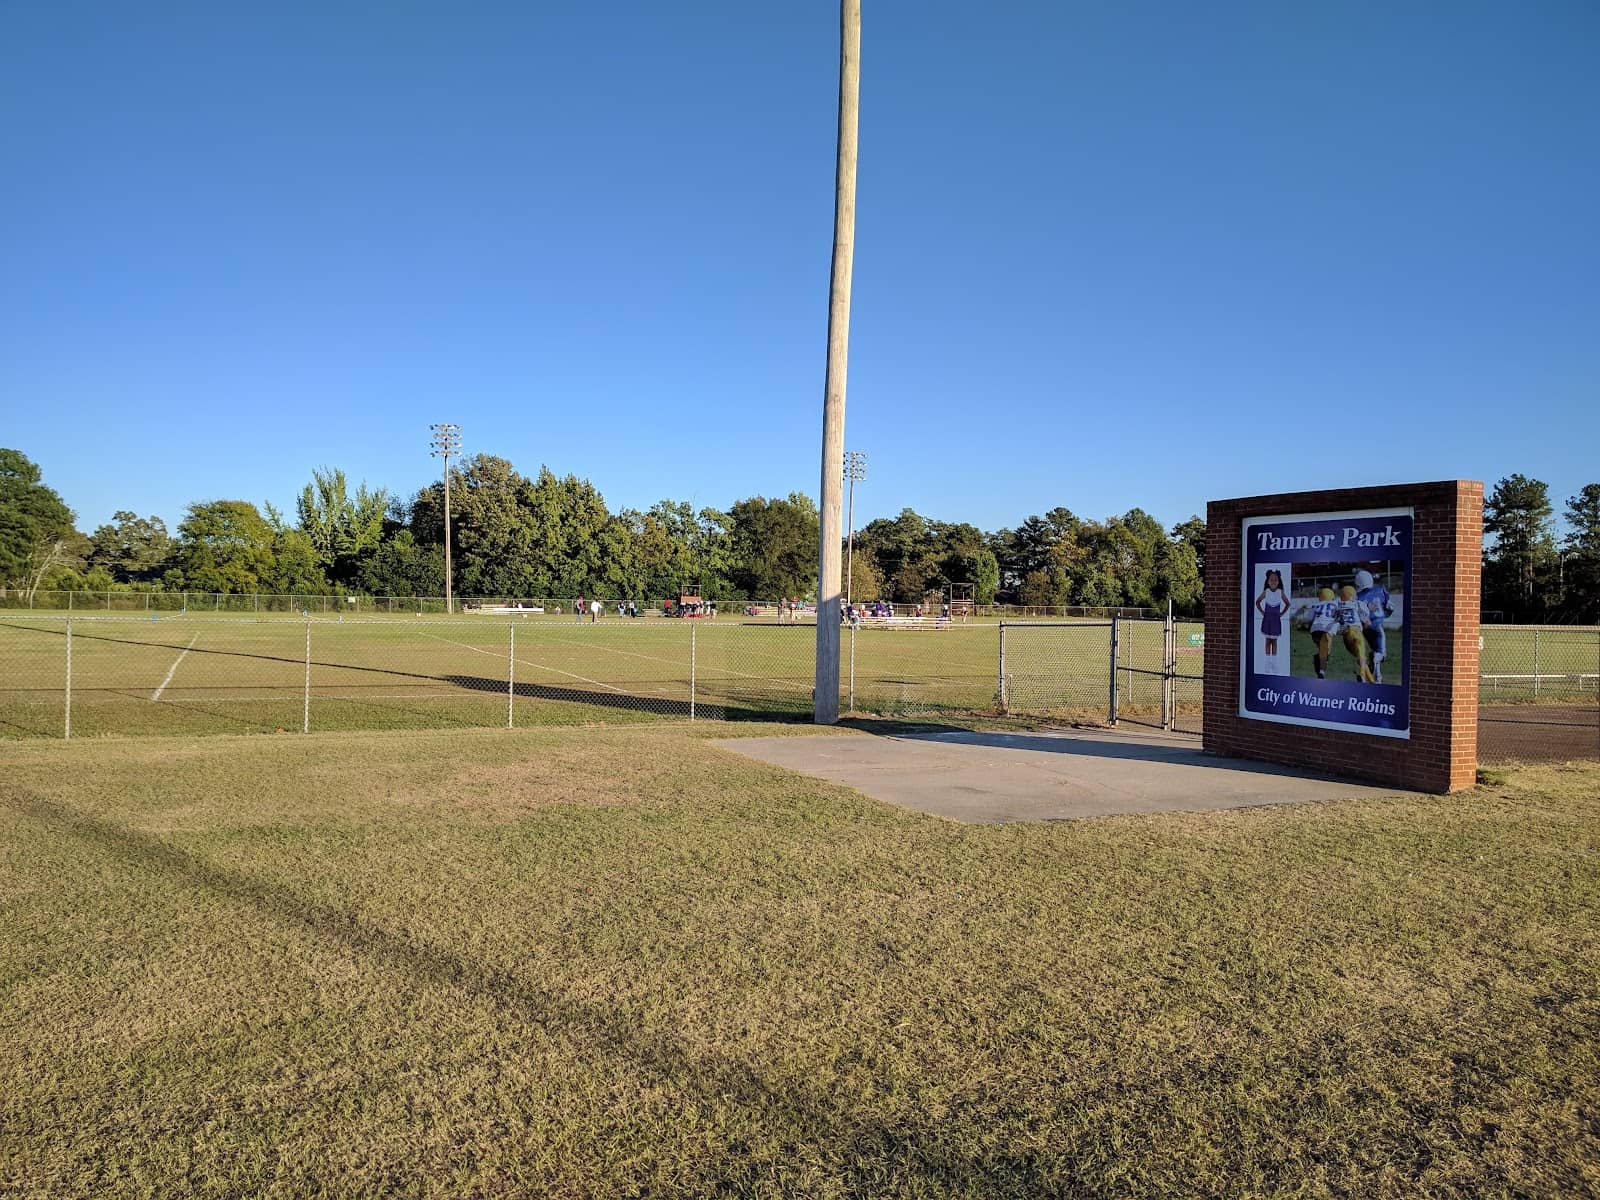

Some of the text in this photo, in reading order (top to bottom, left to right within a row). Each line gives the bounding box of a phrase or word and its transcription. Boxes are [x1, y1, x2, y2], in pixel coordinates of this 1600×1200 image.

[1257, 525, 1402, 551] Tanner Park
[1257, 688, 1396, 716] City of Warner Robins
